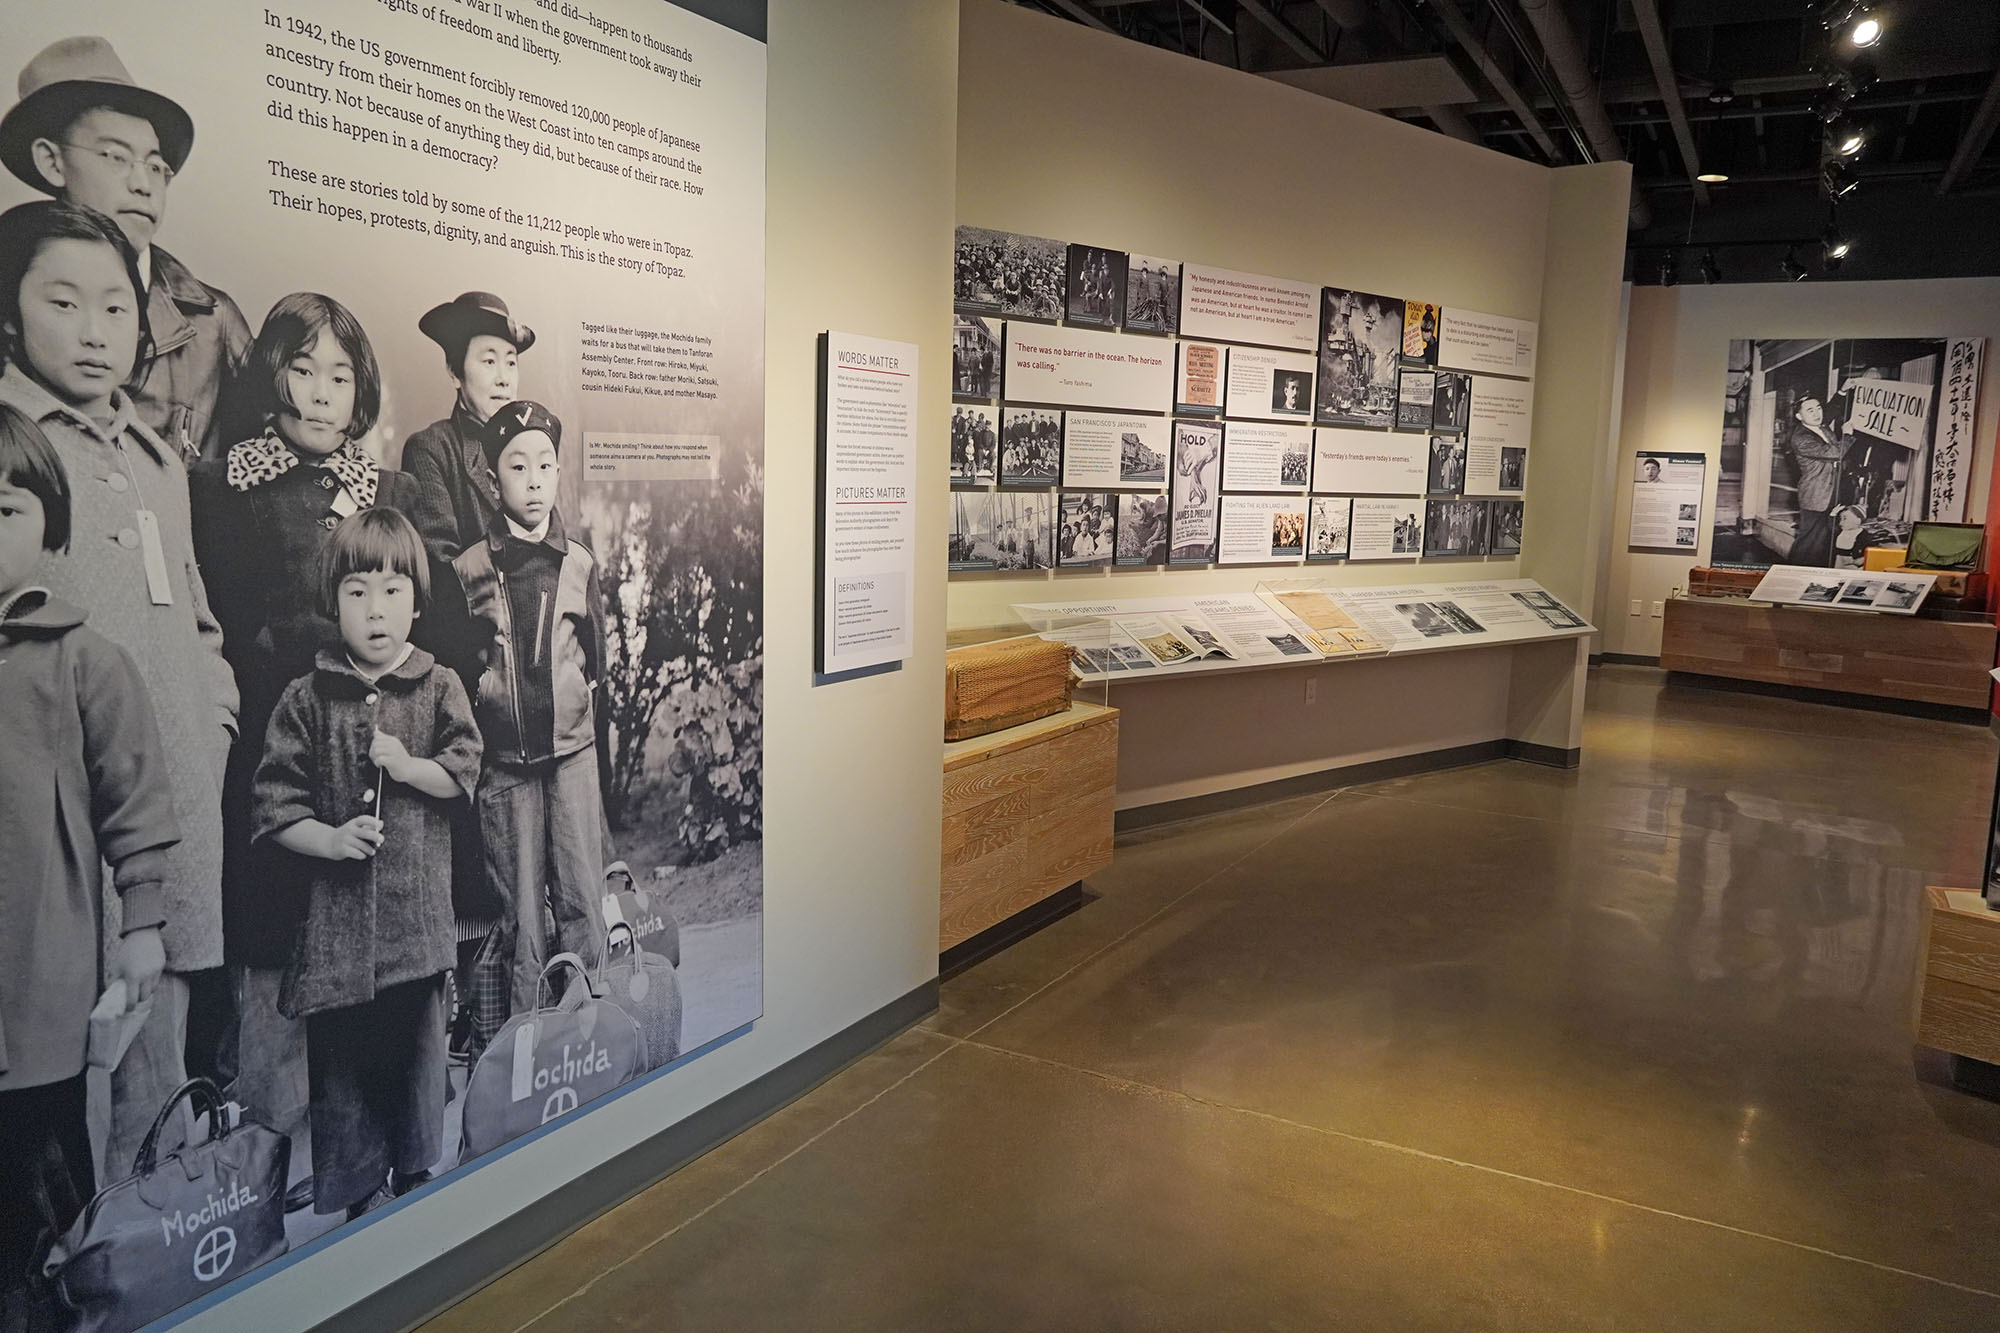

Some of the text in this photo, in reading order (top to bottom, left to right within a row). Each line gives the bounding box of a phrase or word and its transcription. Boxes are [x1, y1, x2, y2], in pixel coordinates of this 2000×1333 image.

[421, 6, 437, 21] of
[439, 9, 493, 40] freedom
[496, 32, 519, 49] and
[522, 36, 561, 65] liberty.
[466, 0, 701, 87] War II when the government took away their
[630, 29, 641, 43] to
[643, 33, 692, 62] thousands
[263, 8, 700, 152] In 1942, the US government forcibly removed 120,000 people of Japanese
[265, 43, 702, 174] ancestry from their homes on the West Coast into ten camps around the
[266, 74, 704, 195] country. Not because of anything they did, but because of their race. How
[267, 100, 498, 172] did this happen in a democracy?
[267, 159, 693, 259] These are stories told by some of the 11,212 people who were in Topaz.
[268, 189, 685, 279] Their hopes, protests, dignity, and anguish. This is the story of Topaz.
[581, 321, 711, 346] Tagged like their luggage, the Mochida family
[581, 338, 599, 347] waits
[599, 338, 609, 347] for
[615, 340, 627, 350] bus
[627, 342, 640, 351] that
[640, 343, 652, 352] will
[652, 345, 665, 353] take
[666, 346, 681, 355] them
[681, 348, 688, 356] to
[581, 351, 612, 365] Assembly
[613, 354, 636, 365] Center.
[636, 356, 653, 366] Front
[653, 360, 667, 368] row:
[837, 350, 898, 369] WORDS MATTER
[1016, 360, 1030, 368] was
[1053, 348, 1062, 356] no
[1062, 347, 1086, 358] barrier
[1087, 350, 1093, 358] in
[1094, 351, 1105, 360] the
[1105, 354, 1126, 362] ocean.
[1127, 354, 1139, 363] The
[1139, 356, 1162, 365] horizon
[581, 367, 606, 378] Kayoko,
[628, 370, 644, 380] Back
[644, 373, 658, 381] row:
[658, 373, 676, 382] father
[581, 383, 602, 391] cousin
[603, 383, 623, 392] Hideki
[644, 386, 663, 396] Kikue,
[663, 388, 674, 396] and
[674, 389, 695, 397] mother
[1856, 386, 1926, 419] EVACUATION
[1180, 434, 1207, 446] HOLD
[835, 486, 905, 498] PICTURES MATTER
[837, 580, 874, 593] DEFINITIONS
[534, 1040, 613, 1091] ochida
[161, 1181, 259, 1247] Mochida
